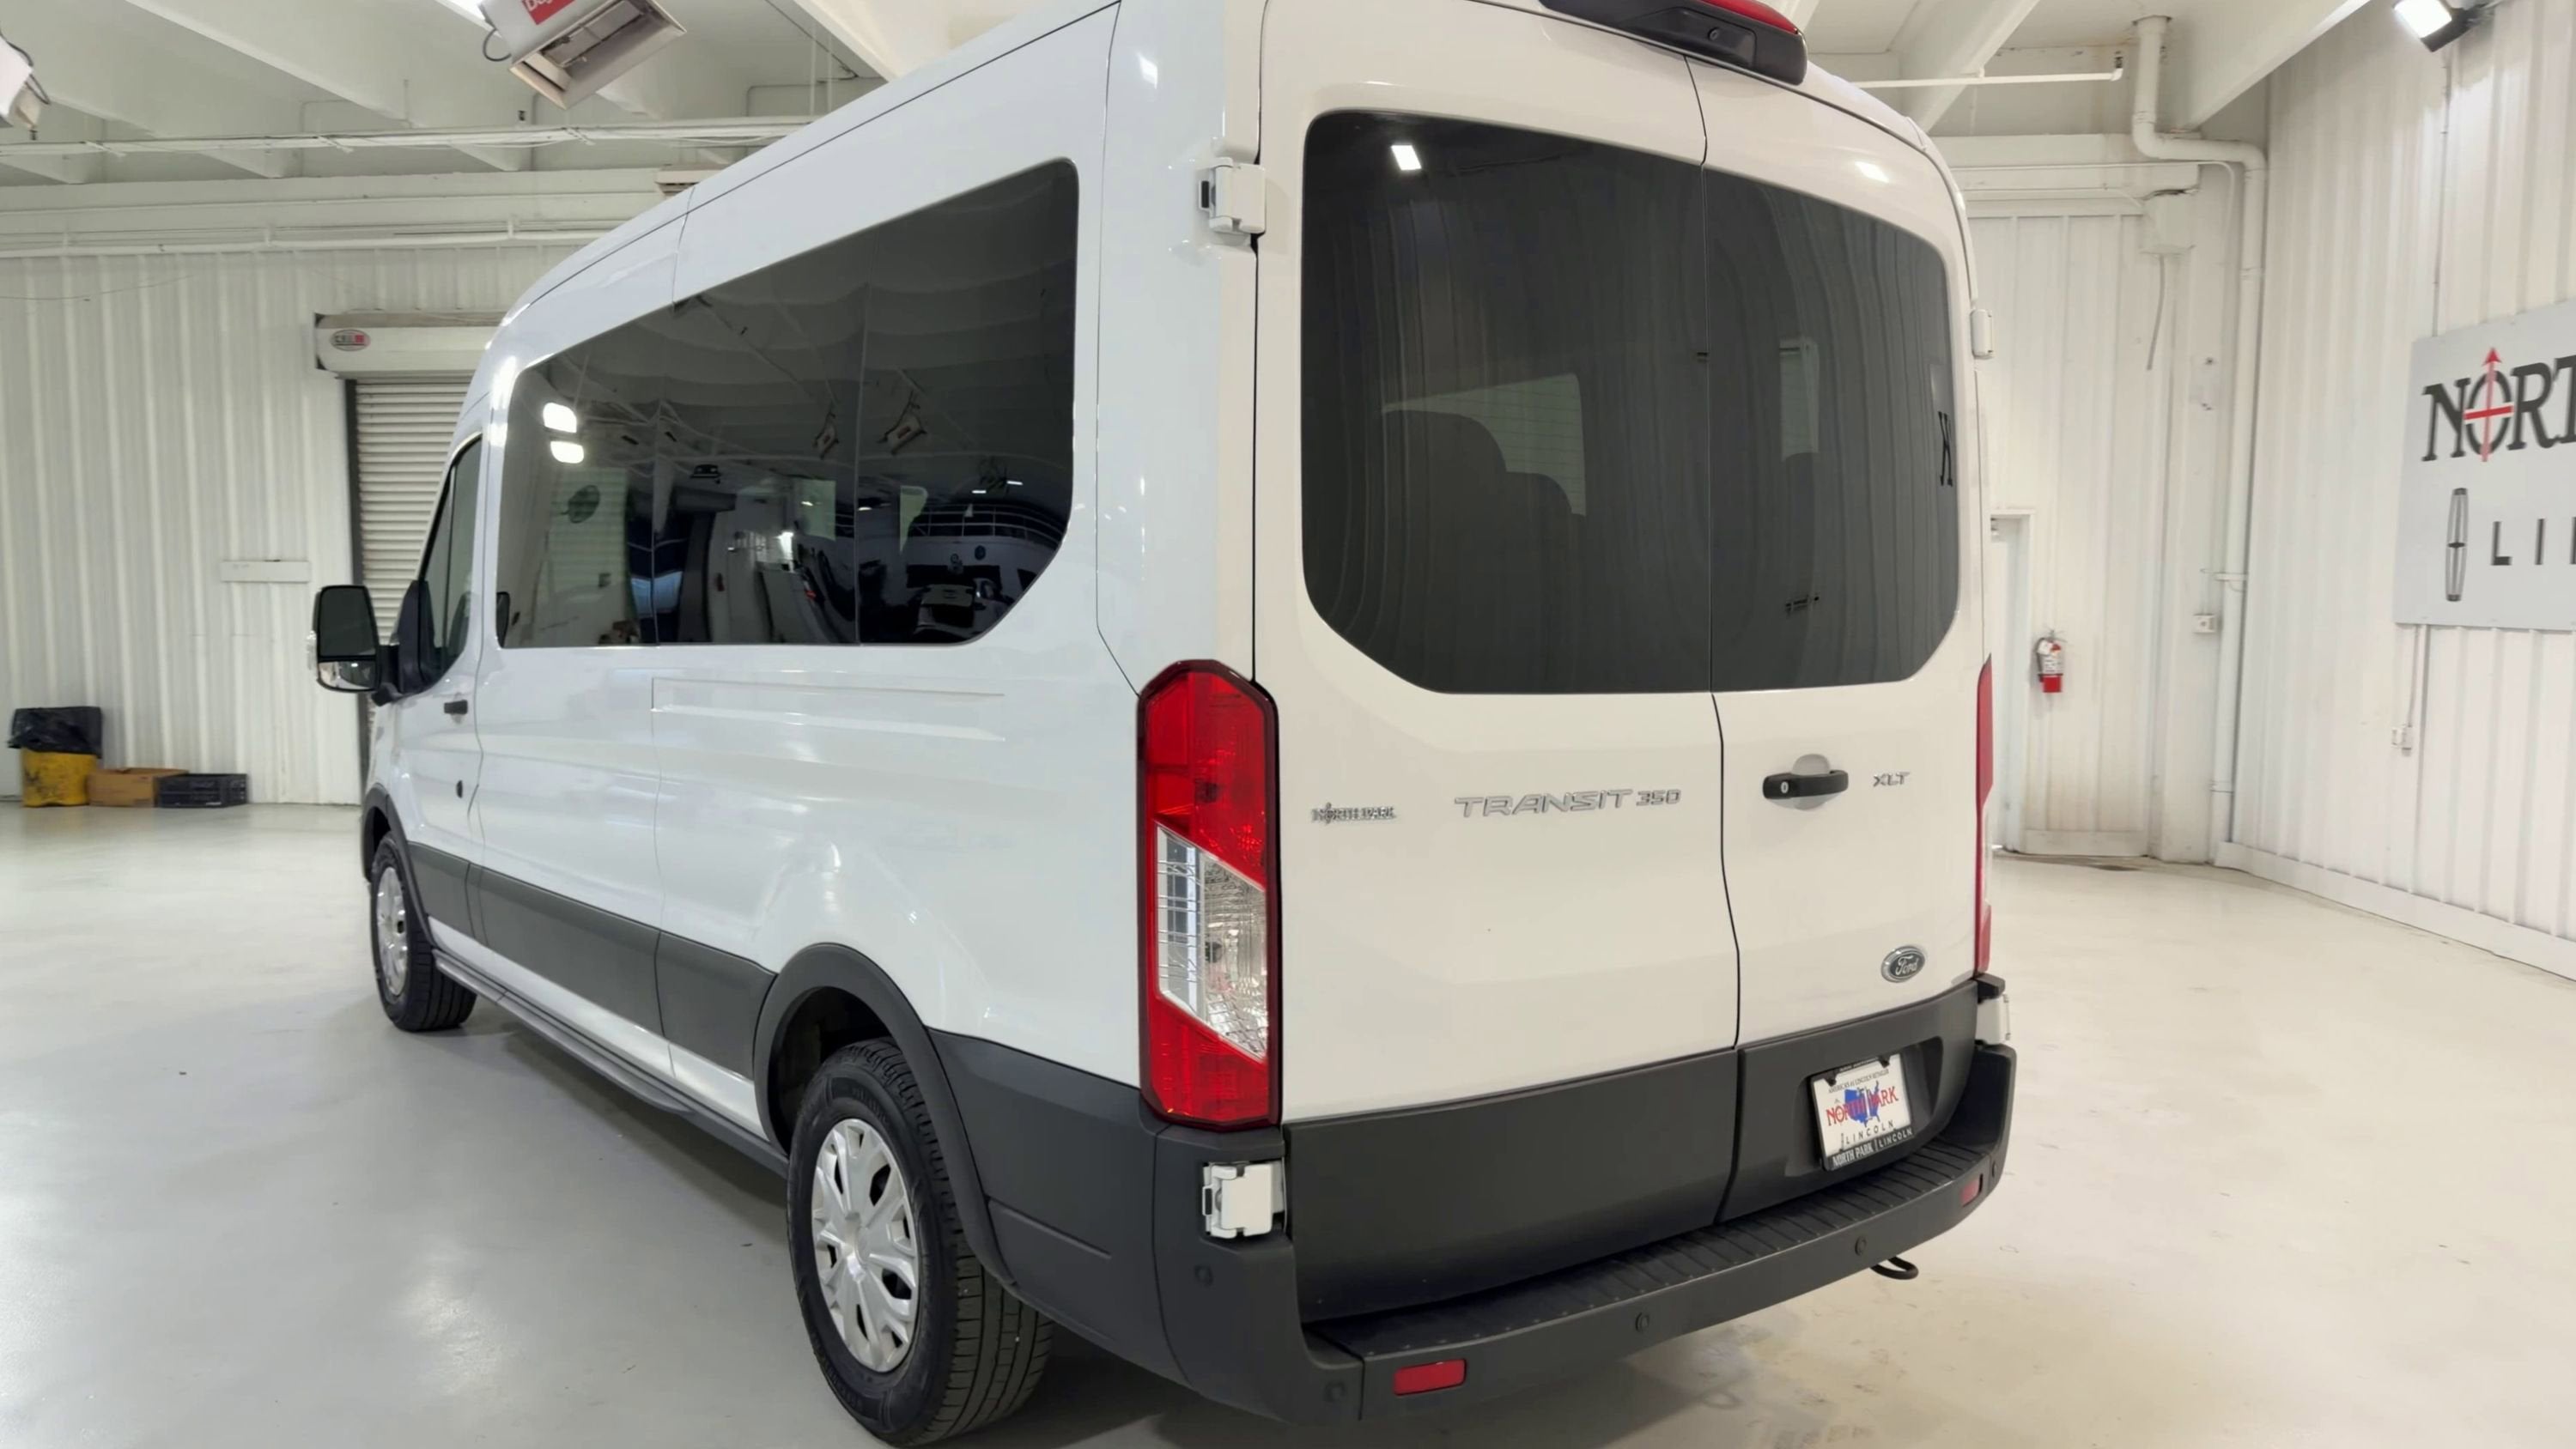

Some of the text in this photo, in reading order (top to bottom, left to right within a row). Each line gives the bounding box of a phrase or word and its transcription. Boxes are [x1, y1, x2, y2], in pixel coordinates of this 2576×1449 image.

[2490, 517, 2576, 567] LI
[1874, 772, 1910, 787] XLT
[1454, 789, 1681, 818] TRANSIT 350
[1895, 955, 1919, 976] Ford
[1826, 1098, 1867, 1126] NORTH
[1846, 1119, 1893, 1144] LINCOLN
[1832, 1127, 1912, 1167] NORTH PARK LINCOLN
